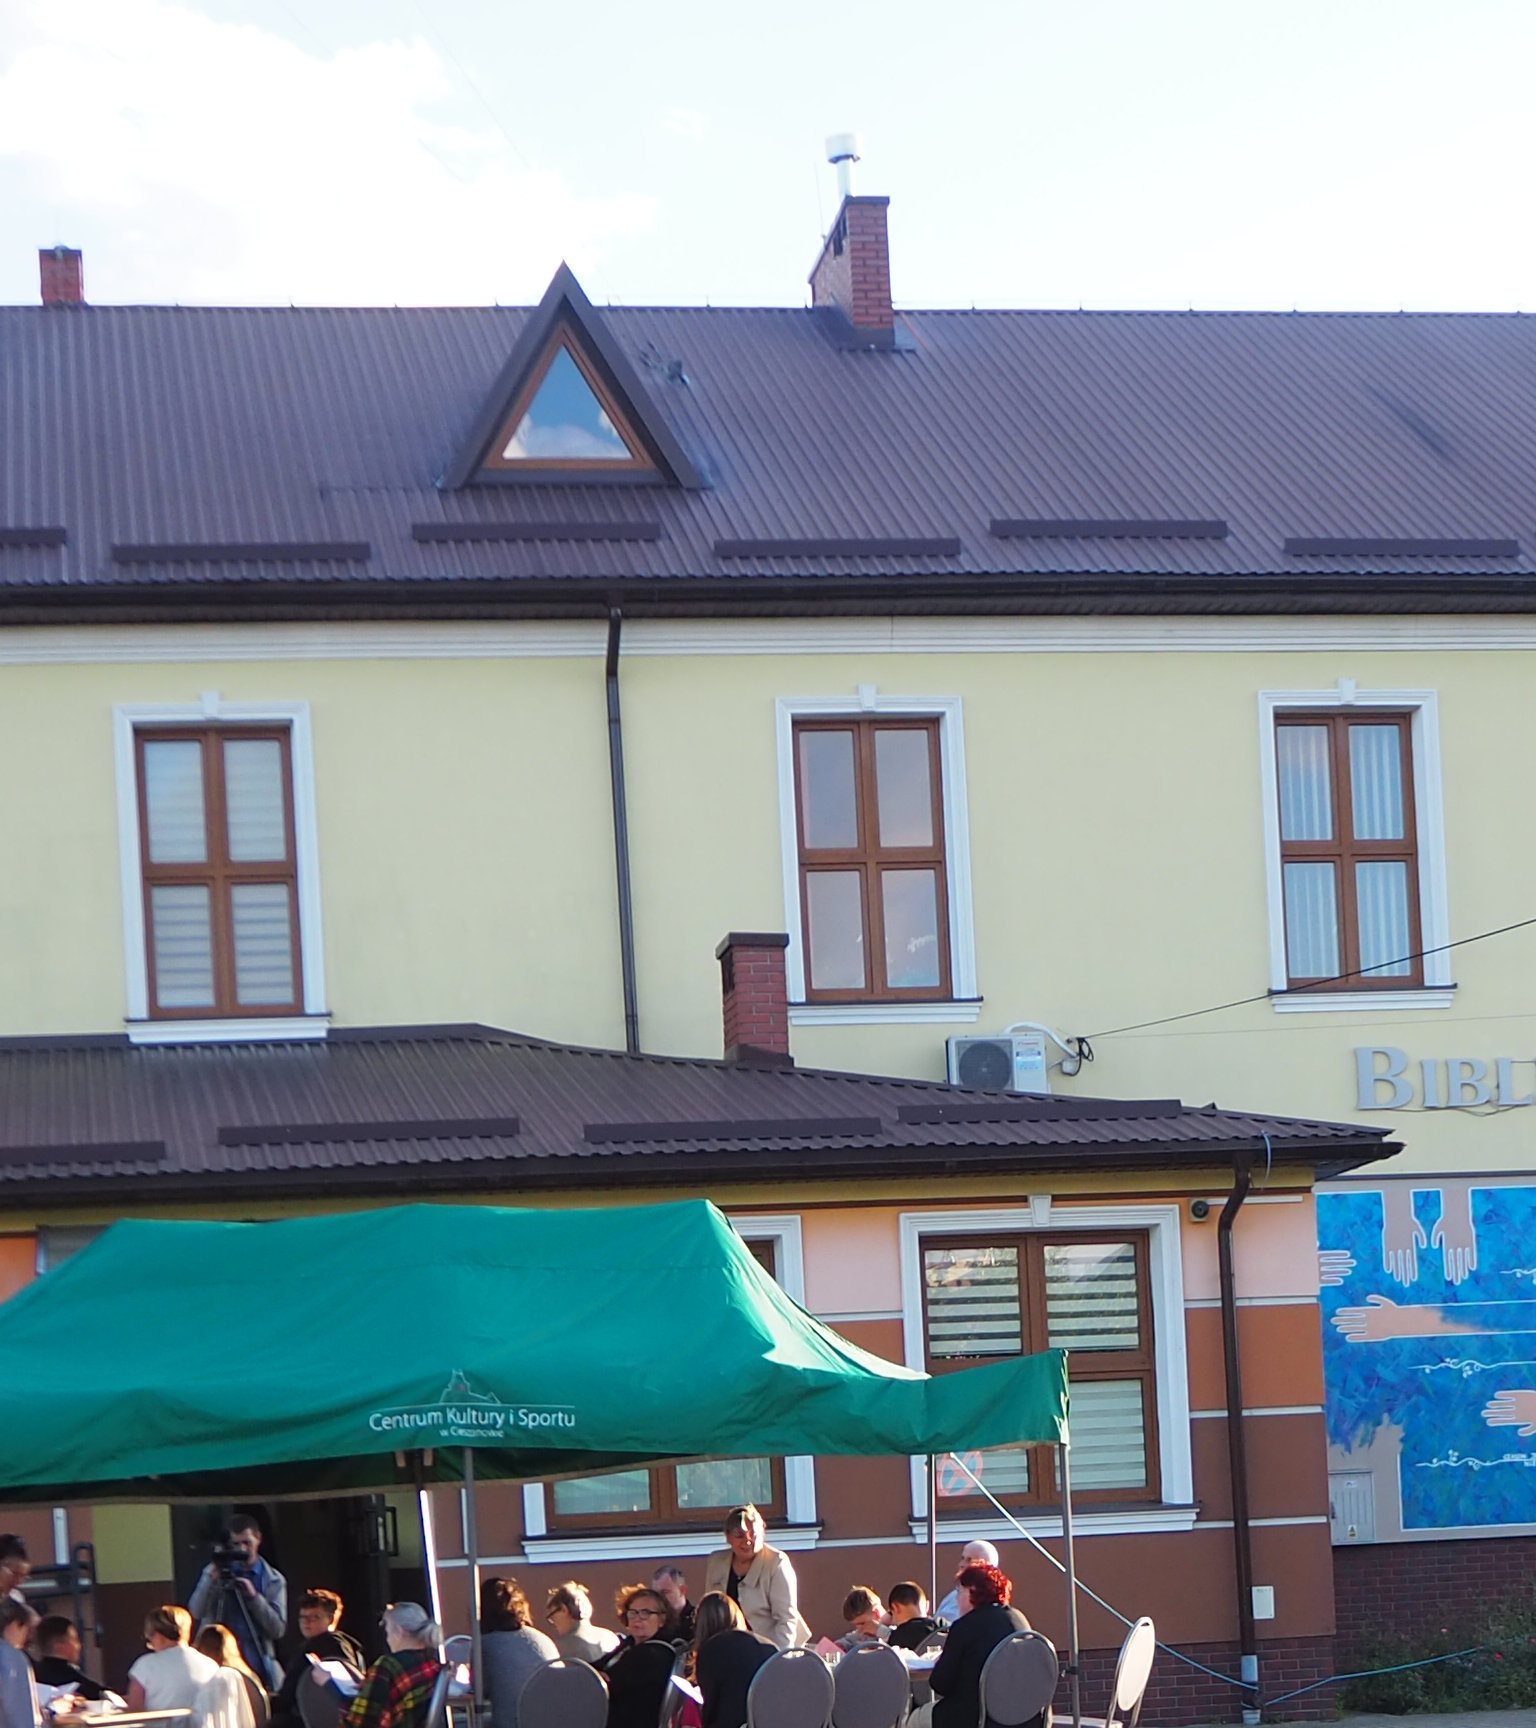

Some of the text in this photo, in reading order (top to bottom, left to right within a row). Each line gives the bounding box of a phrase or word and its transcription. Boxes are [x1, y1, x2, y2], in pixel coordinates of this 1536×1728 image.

[369, 1407, 576, 1431] Centrum Kultury i Sportu
